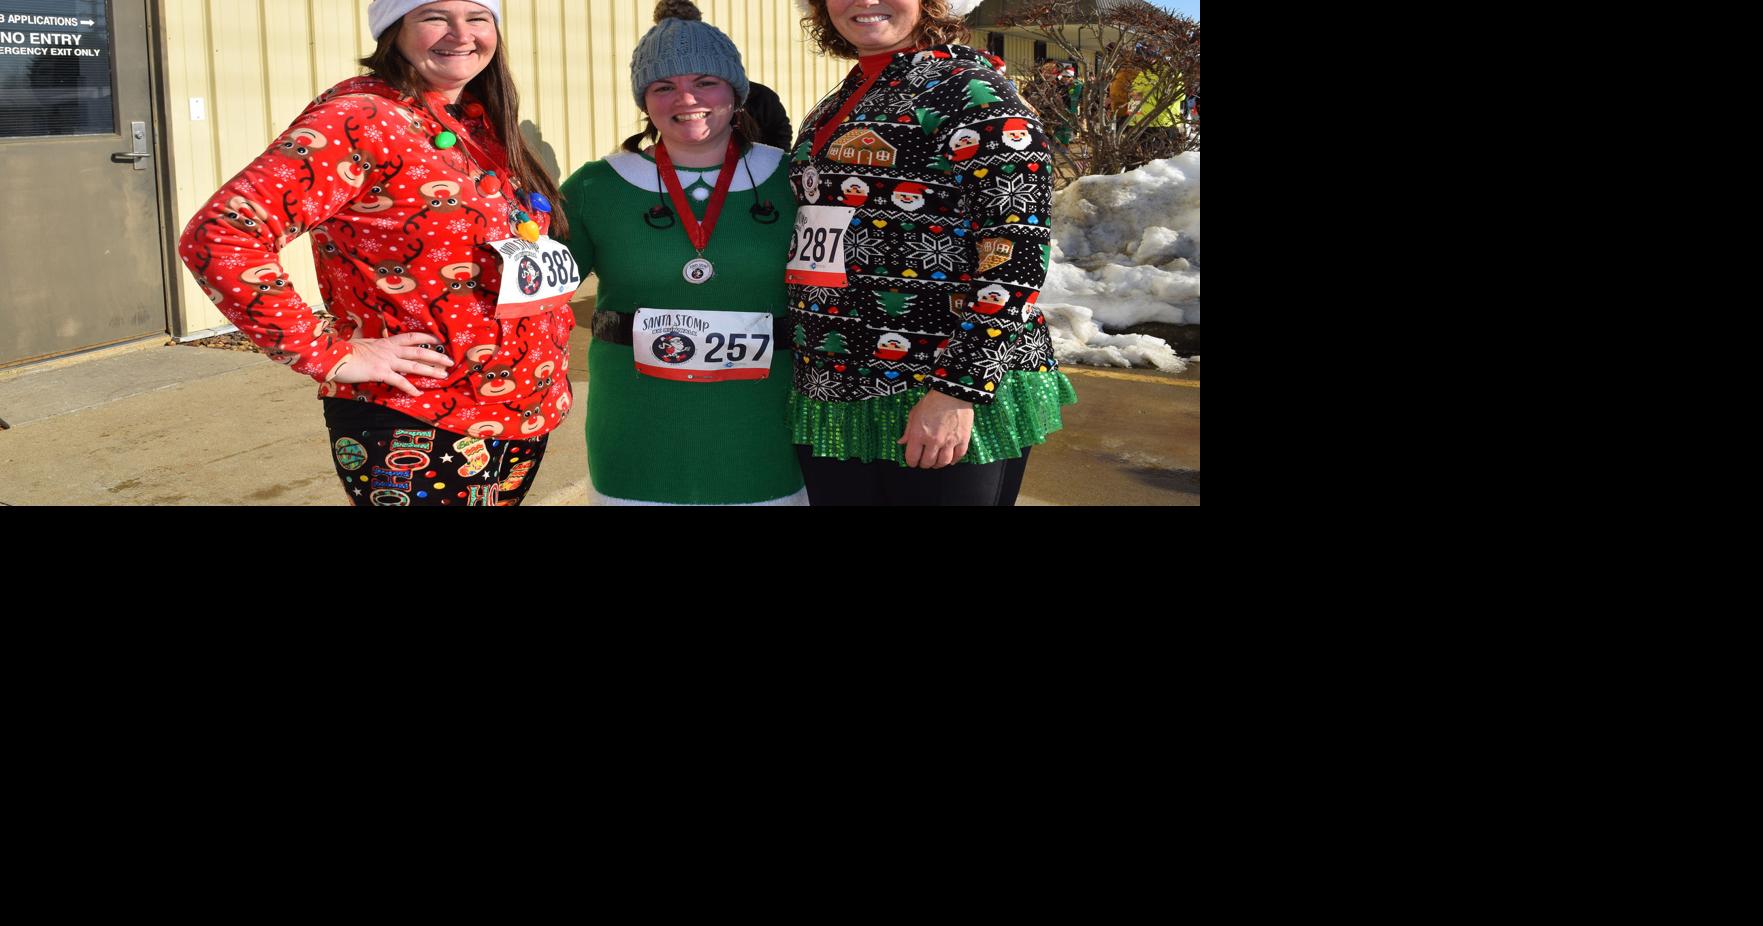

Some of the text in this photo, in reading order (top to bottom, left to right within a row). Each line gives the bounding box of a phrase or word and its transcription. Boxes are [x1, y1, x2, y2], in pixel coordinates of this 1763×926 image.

[8, 14, 78, 26] APPLICATIONS
[0, 31, 82, 46] NO ENTRY
[50, 48, 72, 56] EXIT
[74, 48, 100, 57] ONLY
[799, 227, 844, 263] 287
[541, 249, 579, 287] 382
[642, 314, 672, 331] SANTA
[675, 313, 710, 333] STOMP
[704, 332, 770, 363] 257
